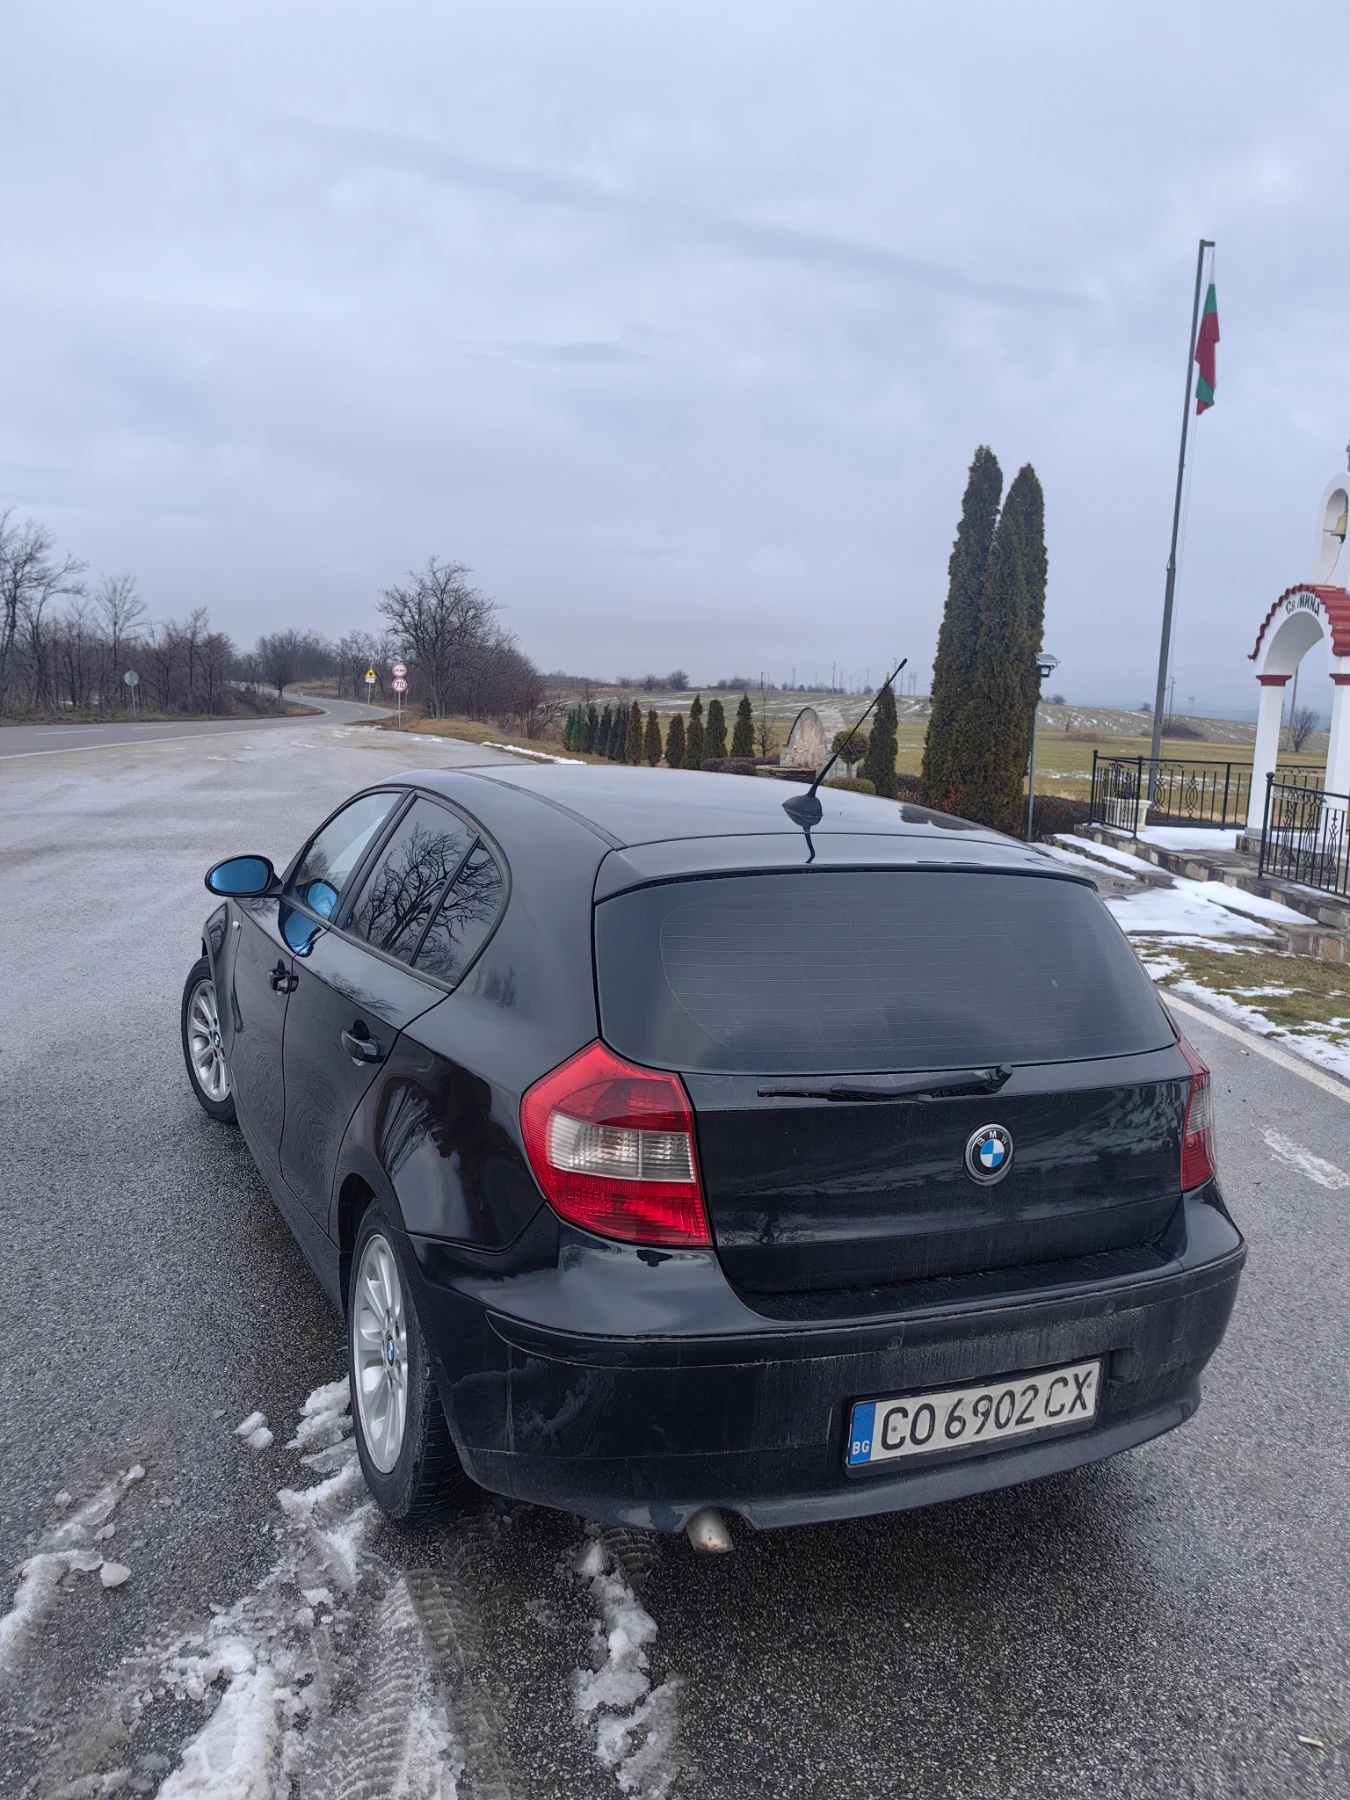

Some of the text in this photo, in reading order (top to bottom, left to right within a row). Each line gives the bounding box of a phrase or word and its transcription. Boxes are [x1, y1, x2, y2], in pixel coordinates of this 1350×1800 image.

[976, 1131, 1009, 1147] BMW
[881, 1370, 1093, 1450] CO 6902 CX
[852, 1440, 870, 1454] BG
